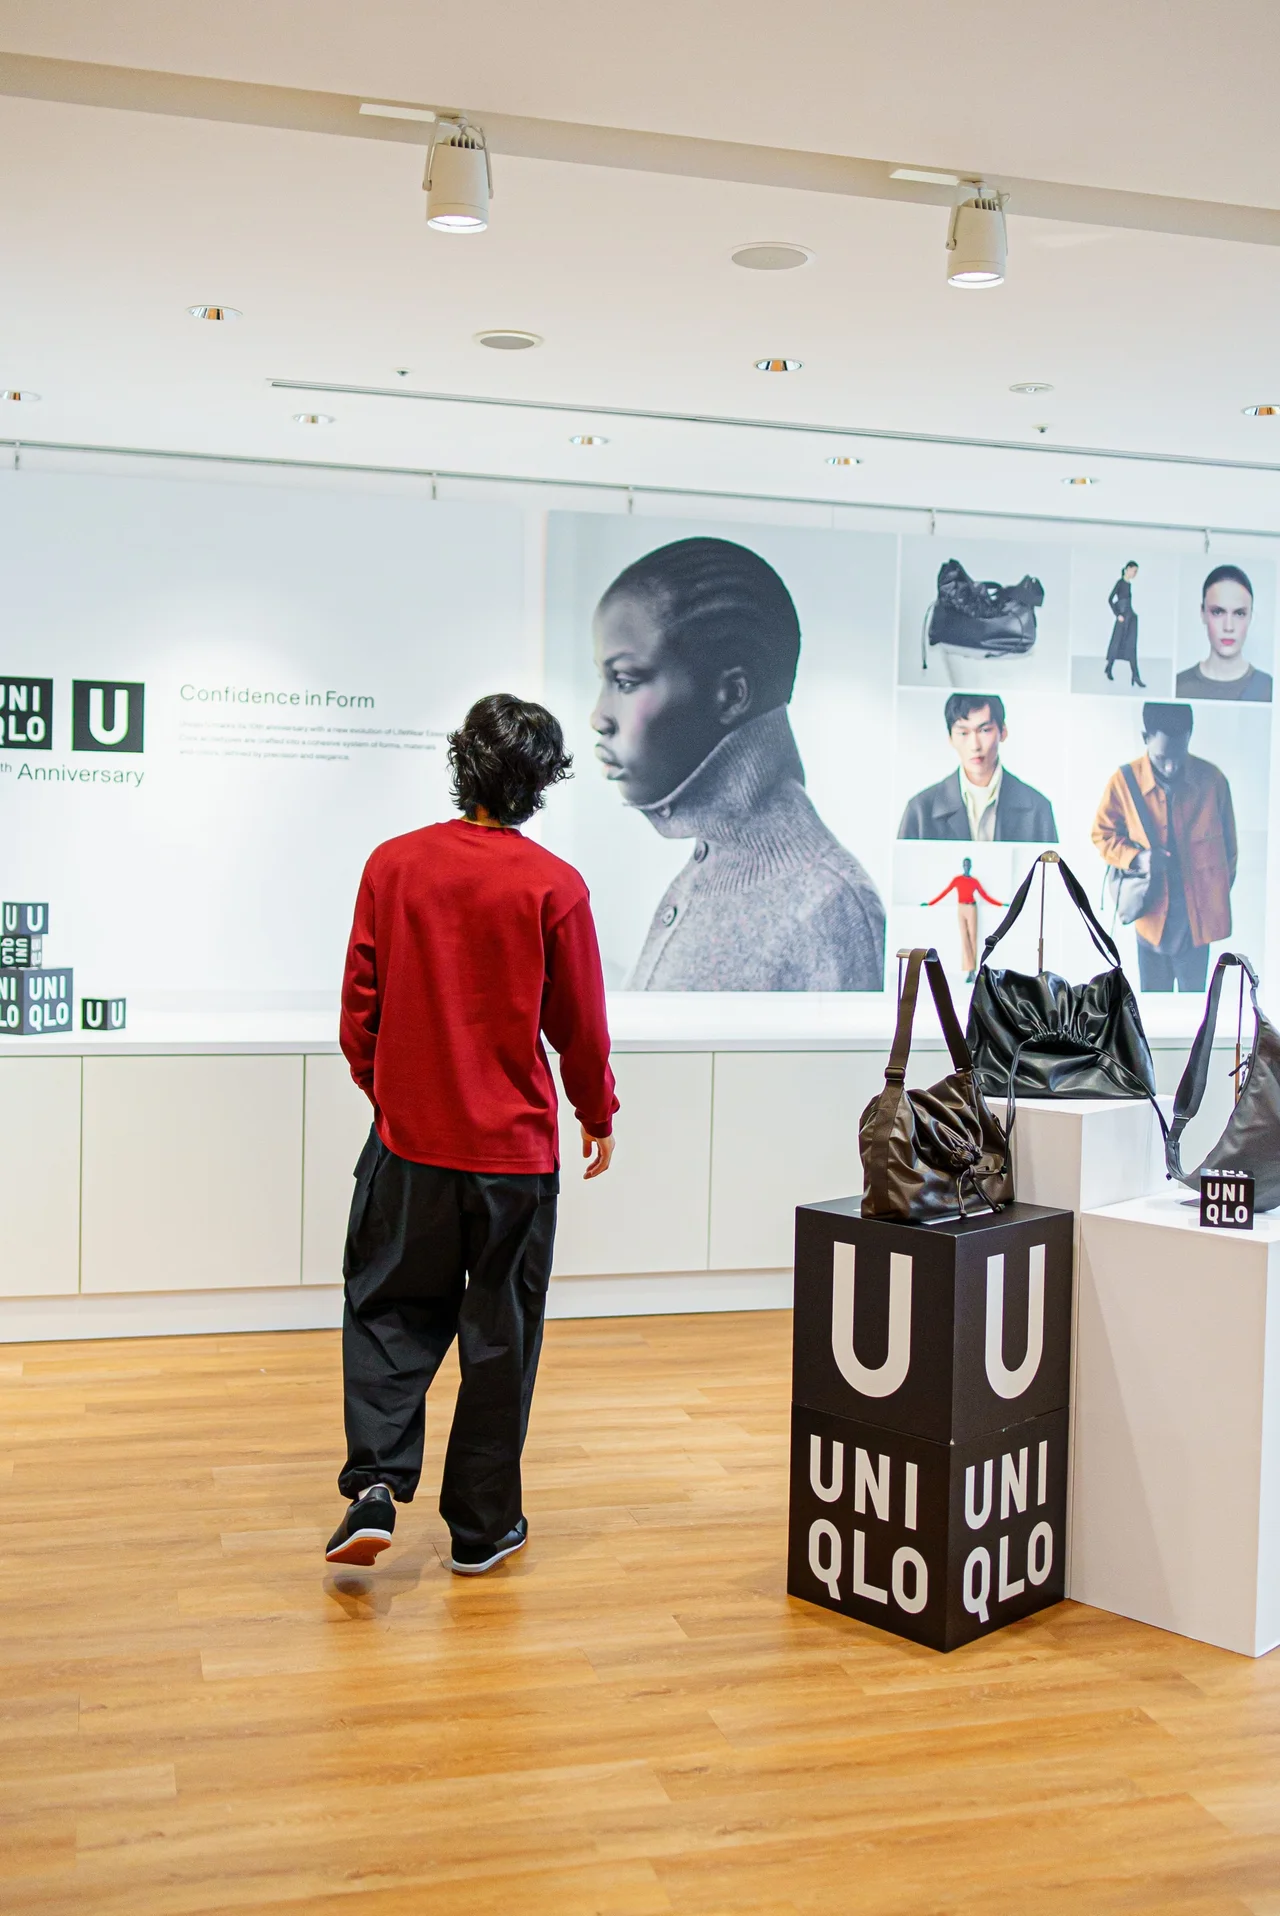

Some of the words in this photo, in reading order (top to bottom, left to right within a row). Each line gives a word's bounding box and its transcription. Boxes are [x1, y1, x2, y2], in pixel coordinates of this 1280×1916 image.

[0, 684, 41, 713] NI
[180, 684, 300, 706] Confidence
[304, 689, 321, 706] in
[325, 690, 375, 709] Form
[0, 715, 46, 746] LO
[89, 688, 129, 746] U
[17, 763, 145, 788] Anniversary
[5, 904, 18, 932] U
[26, 905, 44, 932] U
[15, 938, 28, 964] UNI
[29, 975, 66, 1001] UNI
[28, 1002, 69, 1032] QLO
[86, 1001, 103, 1028] U
[111, 1001, 124, 1028] U
[1206, 1182, 1245, 1203] UNI
[1206, 1203, 1249, 1225] QLO
[832, 1241, 913, 1398] U
[985, 1243, 1046, 1400] U
[810, 1434, 918, 1531] UNI
[964, 1440, 1048, 1530] UNI
[808, 1518, 928, 1614] QLO
[963, 1521, 1054, 1624] QLO
